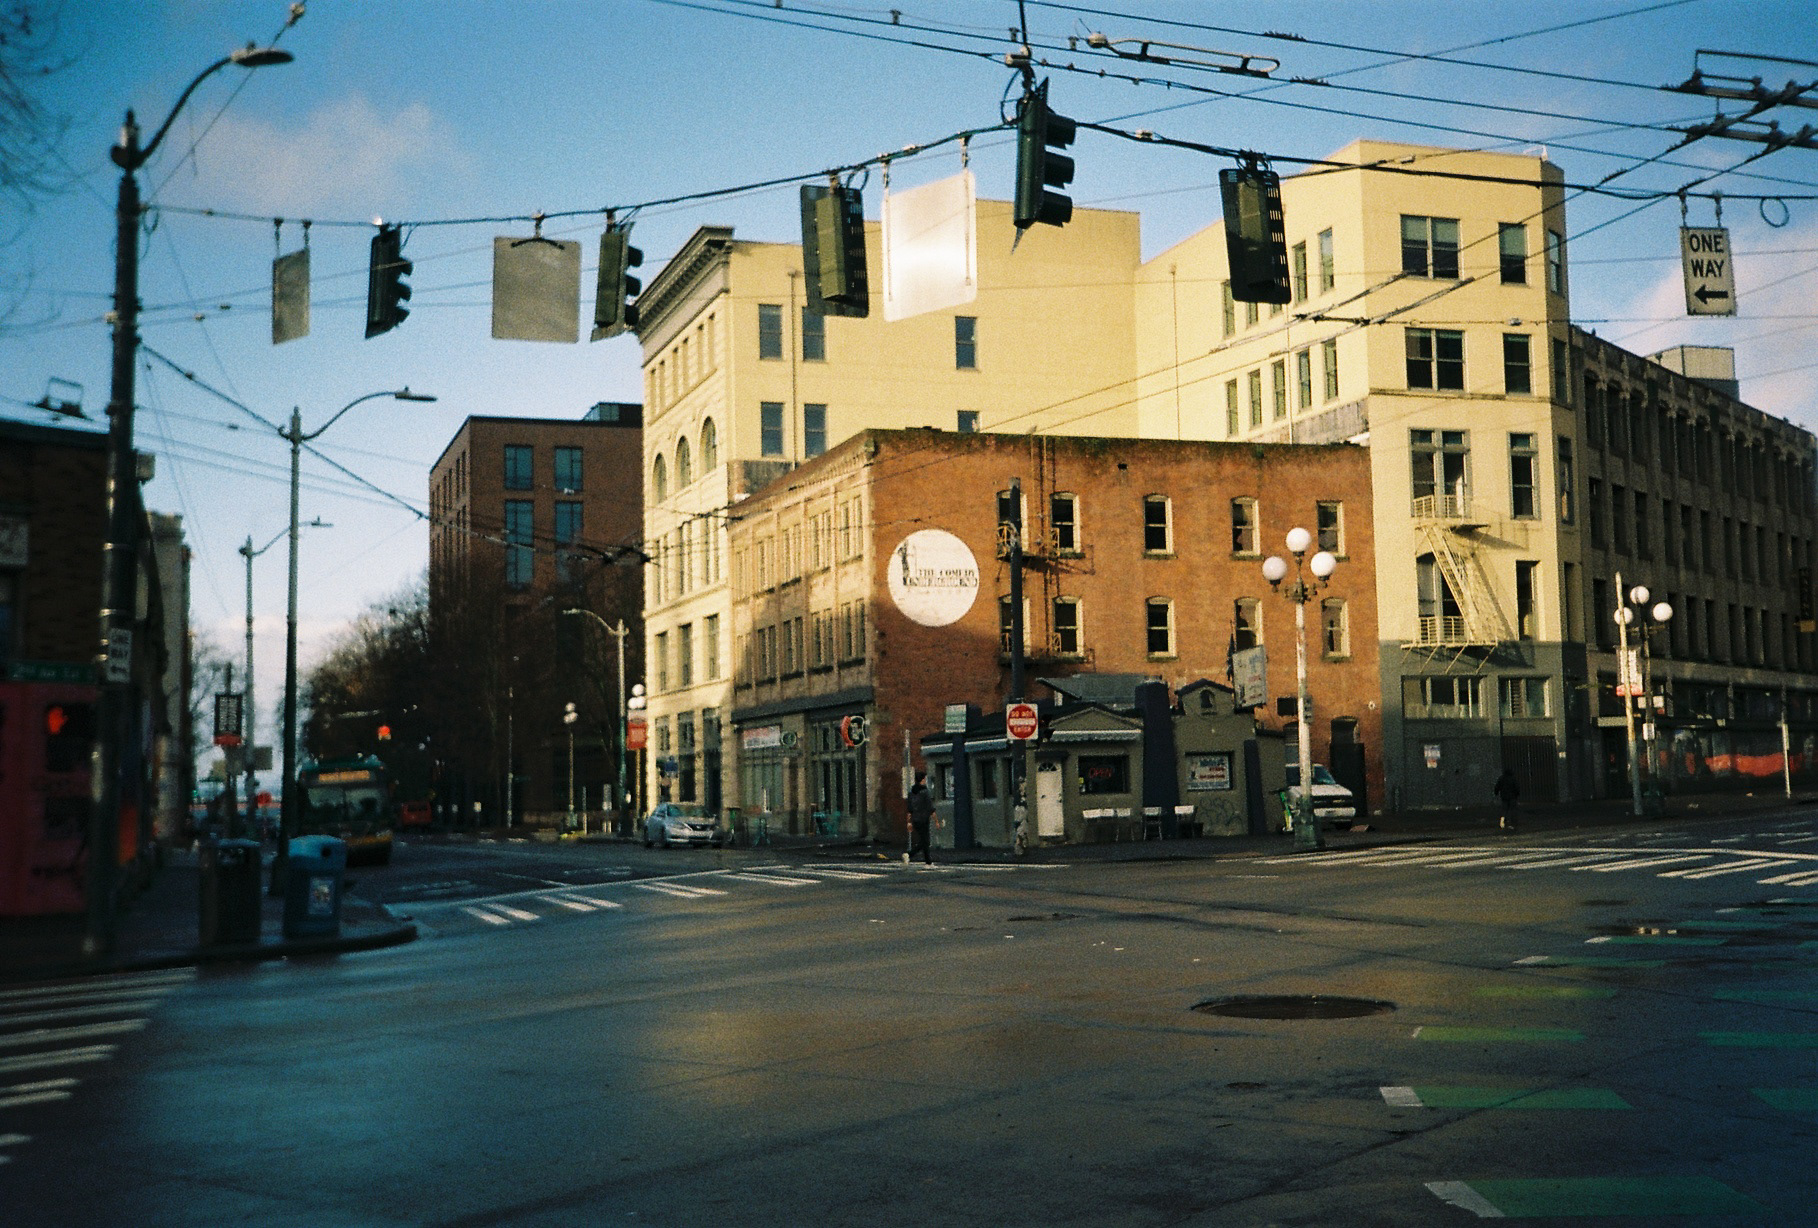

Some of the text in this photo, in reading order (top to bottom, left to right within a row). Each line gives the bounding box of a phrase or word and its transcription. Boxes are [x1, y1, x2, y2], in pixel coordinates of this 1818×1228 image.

[1689, 234, 1724, 253] ONE
[1691, 259, 1724, 277] WAY
[1088, 767, 1113, 778] OPEN
